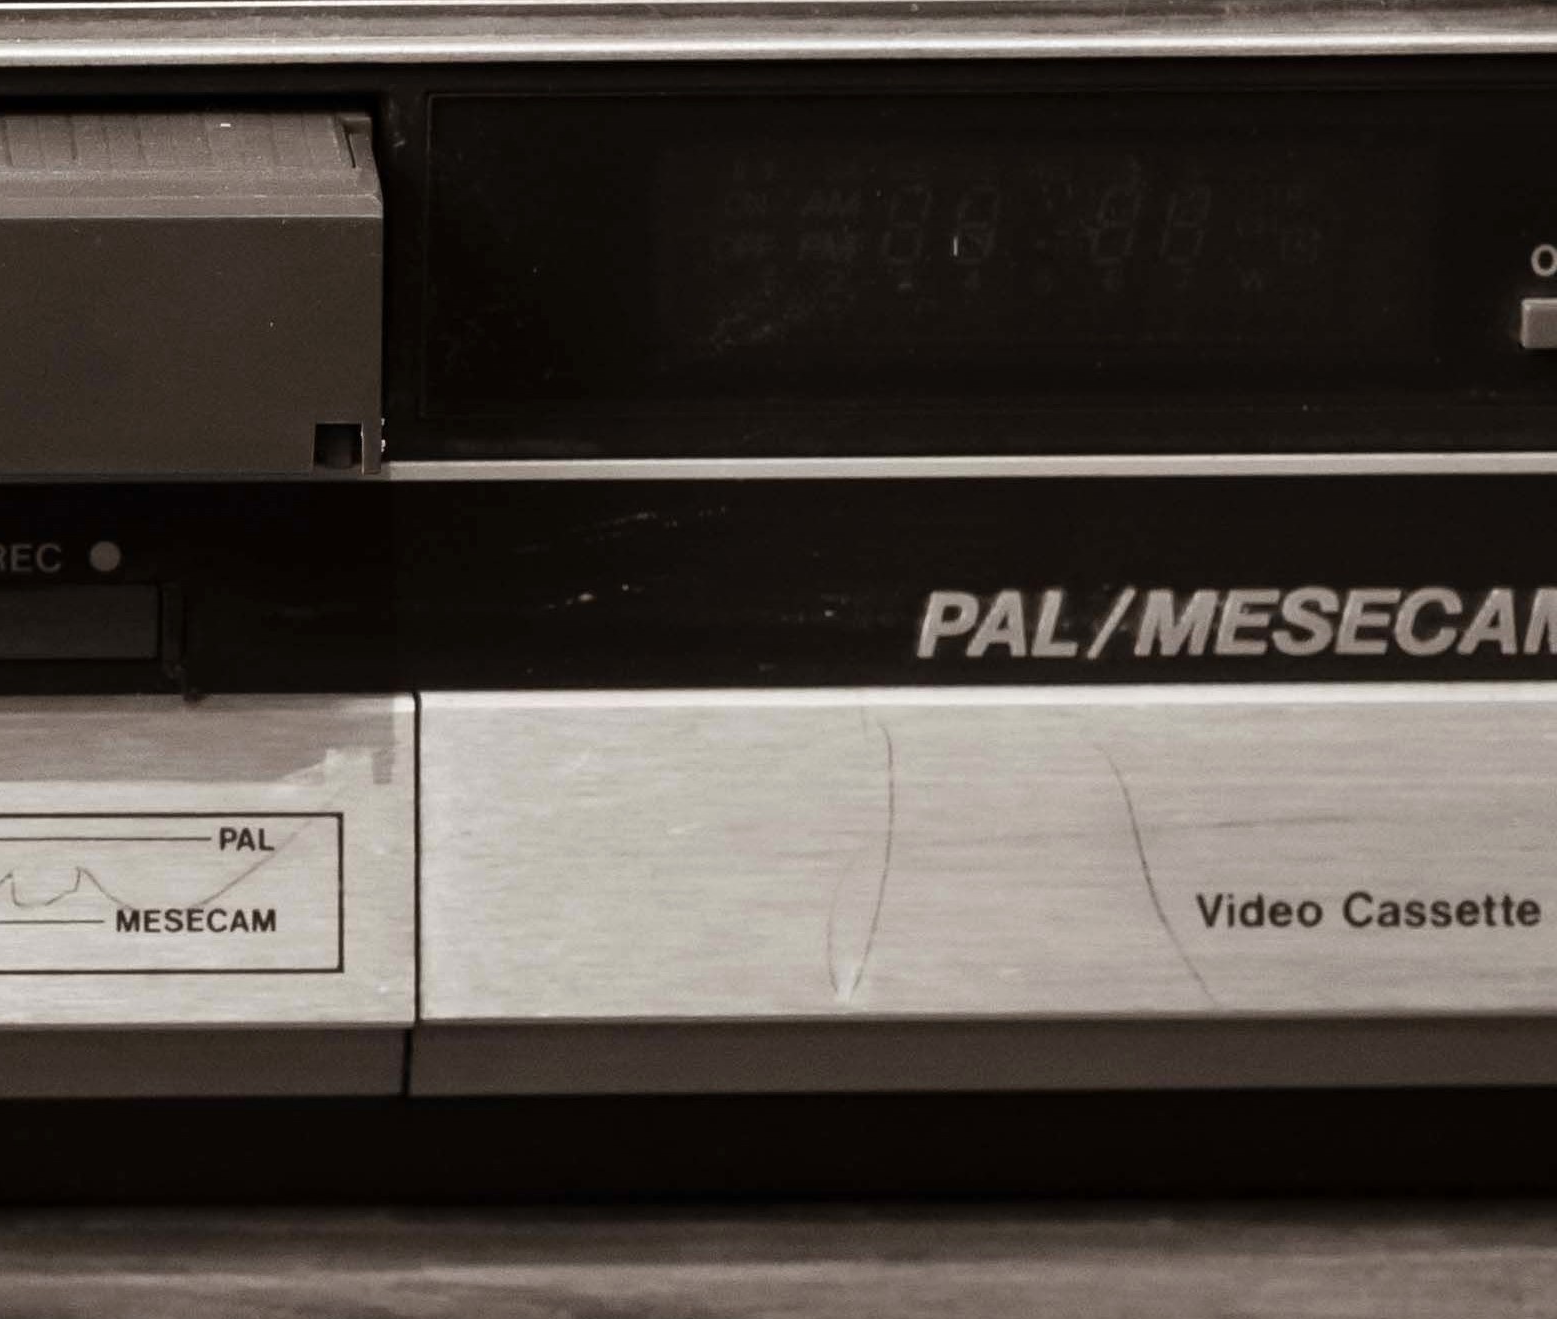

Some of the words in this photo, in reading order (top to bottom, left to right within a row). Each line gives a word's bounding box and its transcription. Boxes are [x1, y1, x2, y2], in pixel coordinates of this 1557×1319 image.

[219, 827, 275, 852] PAL
[115, 908, 277, 933] MESECAM
[1196, 894, 1322, 928] Video
[1343, 892, 1541, 928] Cassette
